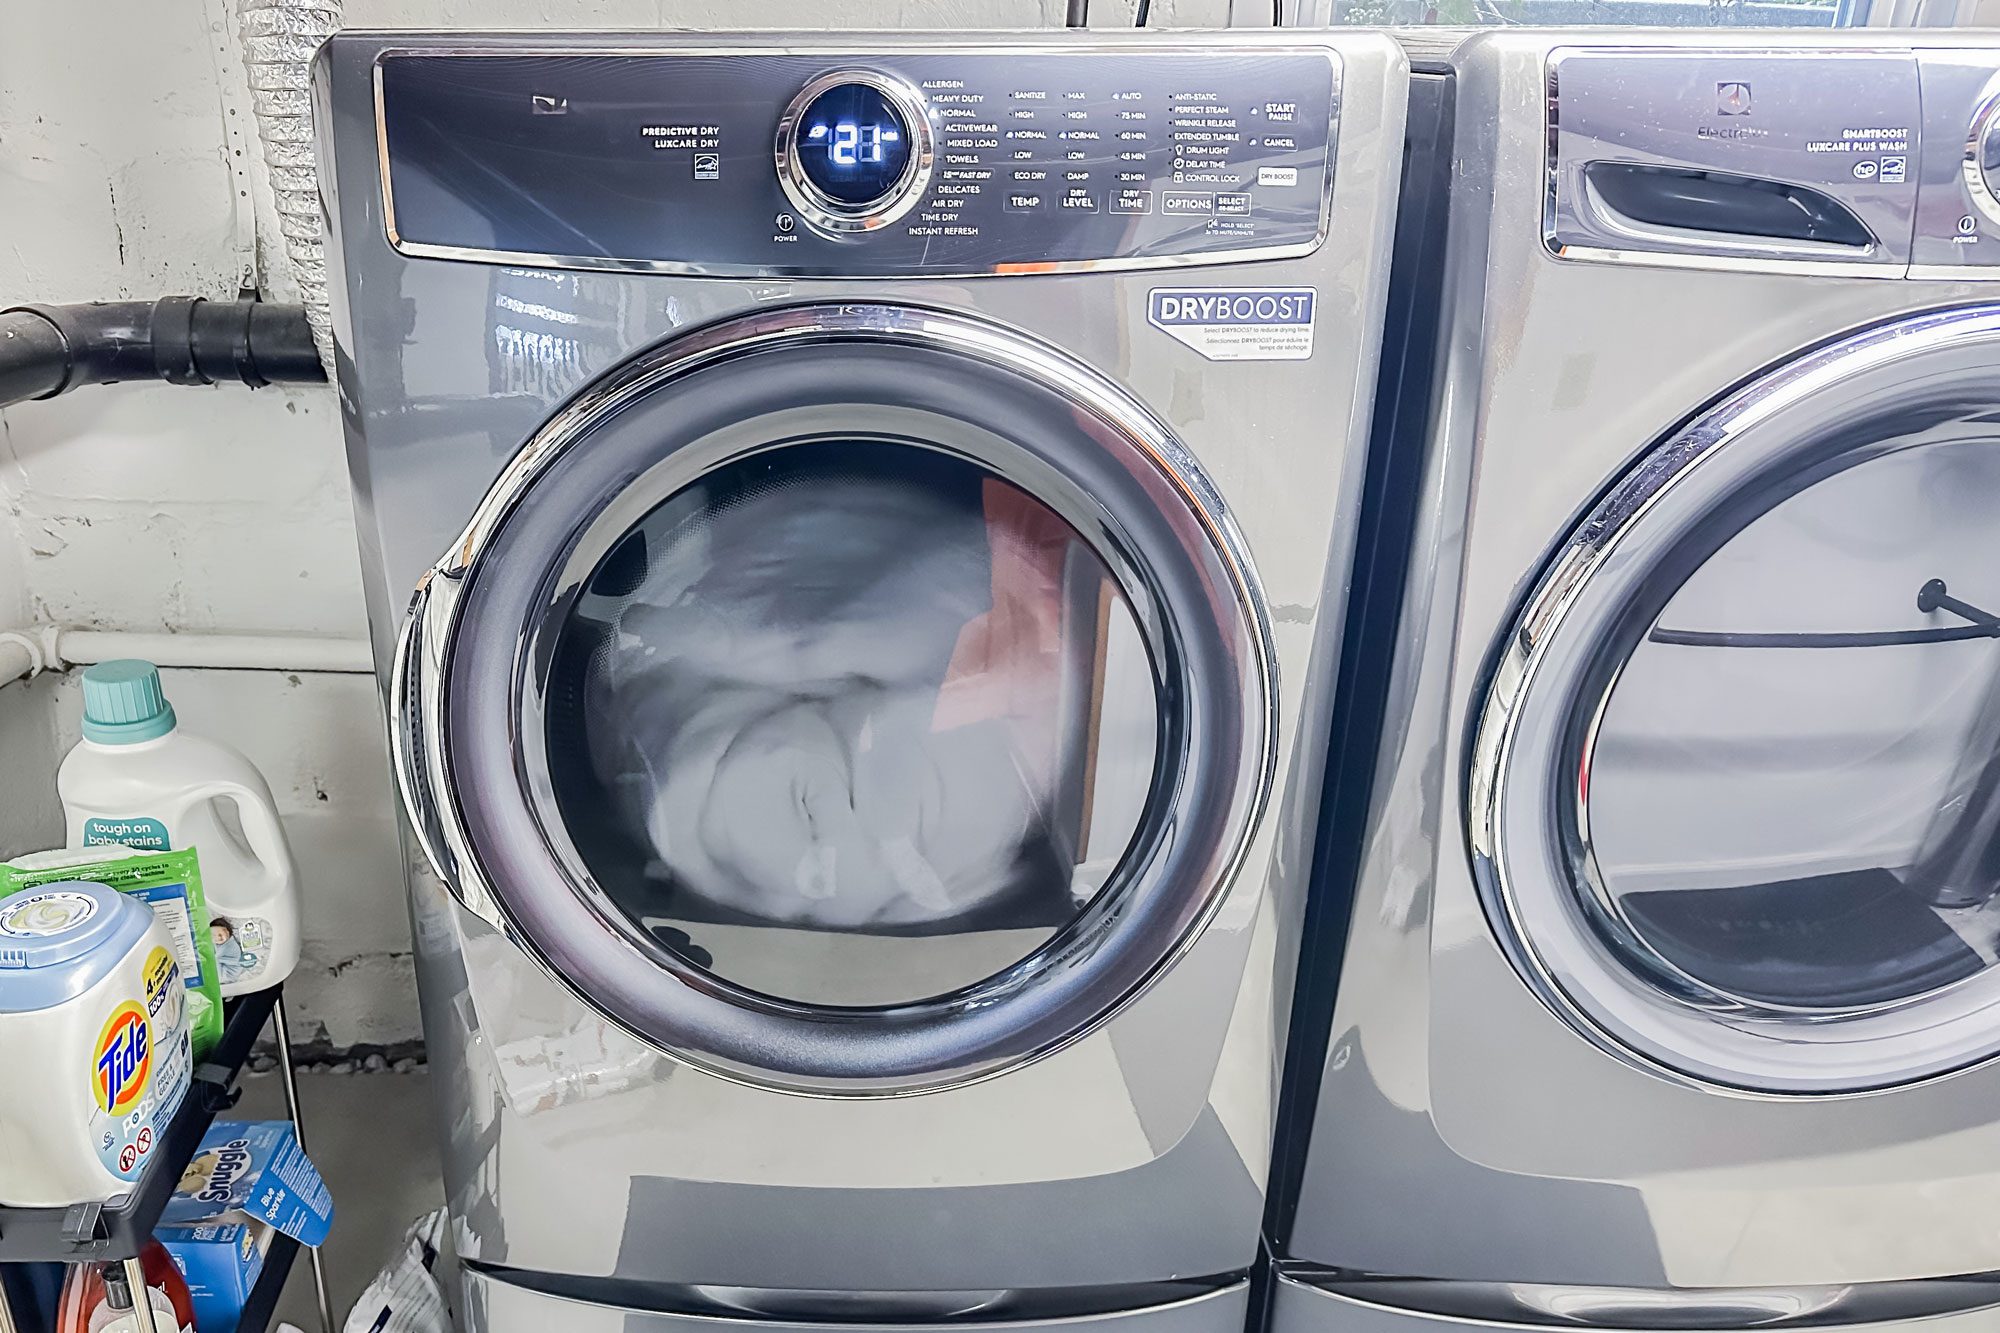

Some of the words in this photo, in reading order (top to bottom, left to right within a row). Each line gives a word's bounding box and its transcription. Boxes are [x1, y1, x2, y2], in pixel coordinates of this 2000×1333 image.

[941, 109, 976, 117] NORMAL
[1265, 103, 1296, 113] START
[642, 127, 698, 136] PREDICTIVE
[700, 127, 720, 135] DRY
[945, 124, 997, 132] ACTIVEWEAR
[1698, 126, 1768, 139] Electrolux
[1014, 131, 1046, 139] NORMAL
[1842, 129, 1908, 139] SMARTBOOST
[655, 139, 697, 148] LUXCARE
[700, 139, 720, 148] DRY
[833, 124, 881, 164] 21
[947, 139, 973, 147] MIXED
[975, 139, 998, 147] LOAD
[1264, 139, 1294, 147] CANCEL
[1807, 142, 1851, 152] LUXCARE
[1853, 142, 1876, 151] PLUS
[1879, 142, 1907, 151] WASH
[946, 155, 979, 163] TOWELS
[938, 186, 980, 194] DELICATES
[1011, 196, 1040, 206] TEMP
[1063, 197, 1093, 207] LEVEL
[1119, 198, 1143, 208] TIME
[1166, 199, 1212, 209] OPTIONS
[1218, 197, 1245, 205] SELECT
[921, 213, 940, 221] TIME
[942, 213, 958, 221] DRY
[909, 227, 942, 235] INSTANT
[945, 227, 978, 235] REFRESH
[1160, 297, 1308, 320] DRYBOOST
[93, 823, 131, 836] tough
[134, 824, 151, 833] on
[88, 834, 121, 846] baby
[122, 835, 162, 846] stains
[98, 1015, 149, 1116] Tide
[122, 1092, 155, 1138] PODS
[198, 1139, 248, 1202] Snuggle
[260, 1187, 276, 1207] Blue
[265, 1188, 287, 1220] Sparkle
